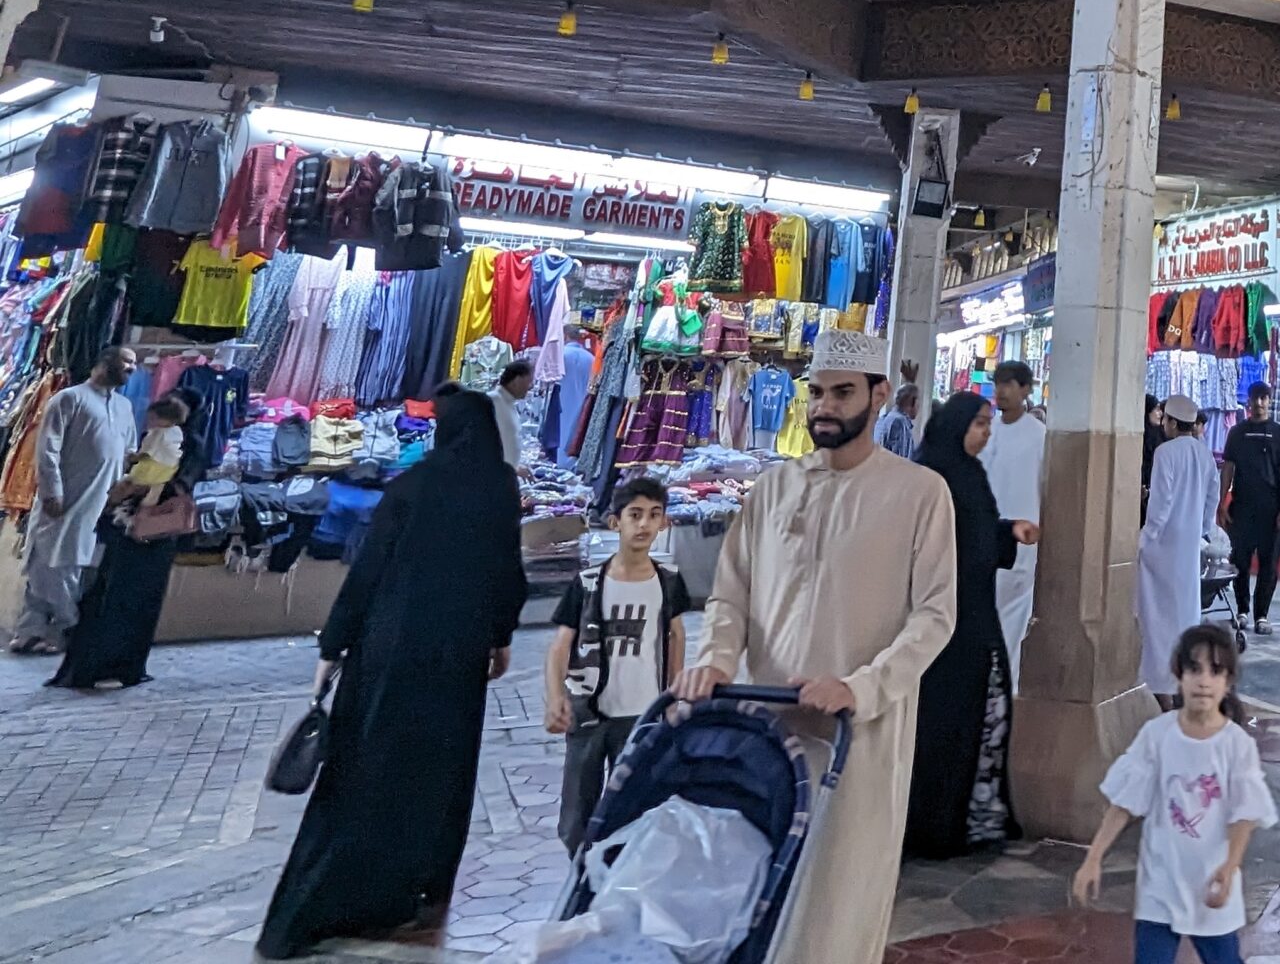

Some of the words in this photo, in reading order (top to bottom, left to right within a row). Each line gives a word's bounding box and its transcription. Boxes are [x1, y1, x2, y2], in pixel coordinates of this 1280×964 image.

[454, 182, 574, 219] READYMADE
[583, 198, 685, 231] GARMENTS
[592, 178, 689, 205] الملابس
[1241, 209, 1269, 240] شركة
